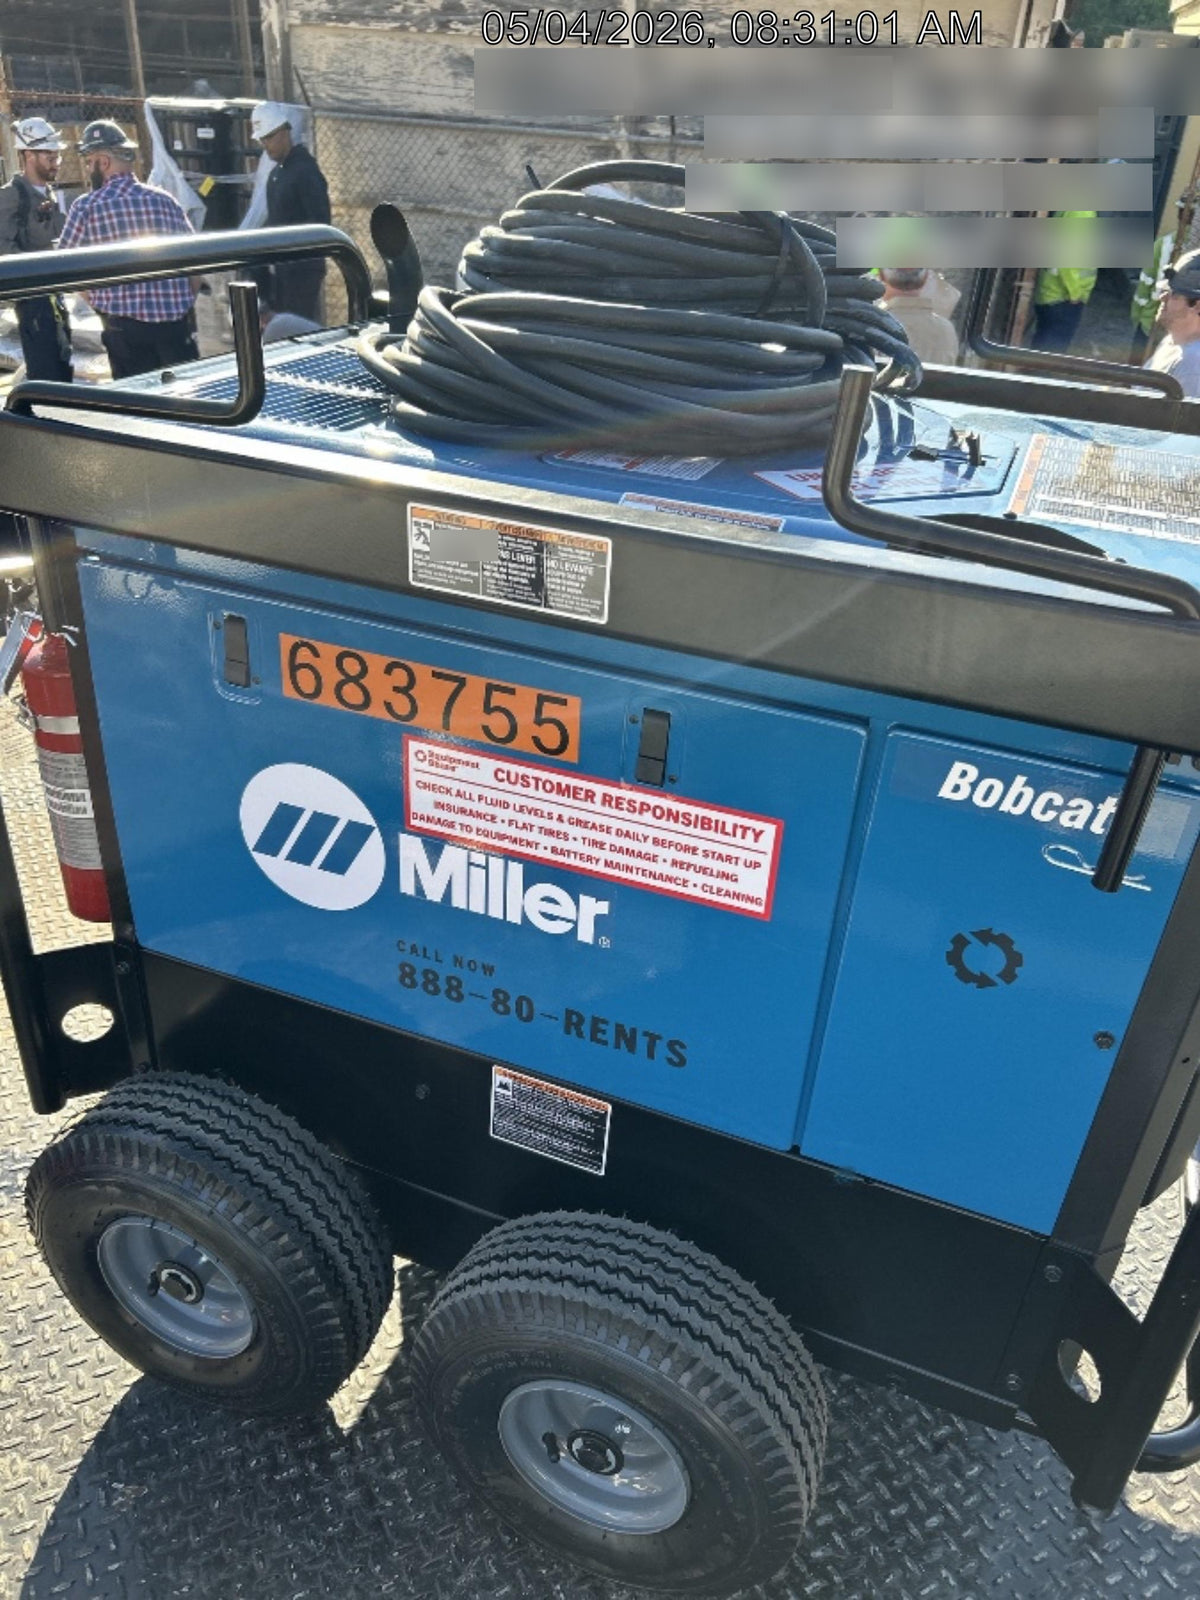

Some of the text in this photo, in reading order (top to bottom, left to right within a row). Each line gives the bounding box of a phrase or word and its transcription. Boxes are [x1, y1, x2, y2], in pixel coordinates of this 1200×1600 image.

[288, 639, 570, 757] 683755
[415, 778, 762, 872] CHECK ALL FLUID LEVELS & GREASE DAILY BEFORE START UP
[433, 799, 738, 884] INSURANCE FLAT TIRES TIRE DAMAGE REFUELING
[494, 766, 765, 845] CUSTOMER RESPONSIBILITY
[937, 761, 1118, 835] Bobcat
[398, 833, 610, 945] Miller
[411, 810, 763, 908] DAMAGE TO EQUIPMENT BATTERY MAINTENANCE CLEANING
[397, 939, 496, 977] CALL NOW
[397, 961, 688, 1068] 888-80-RENTS
